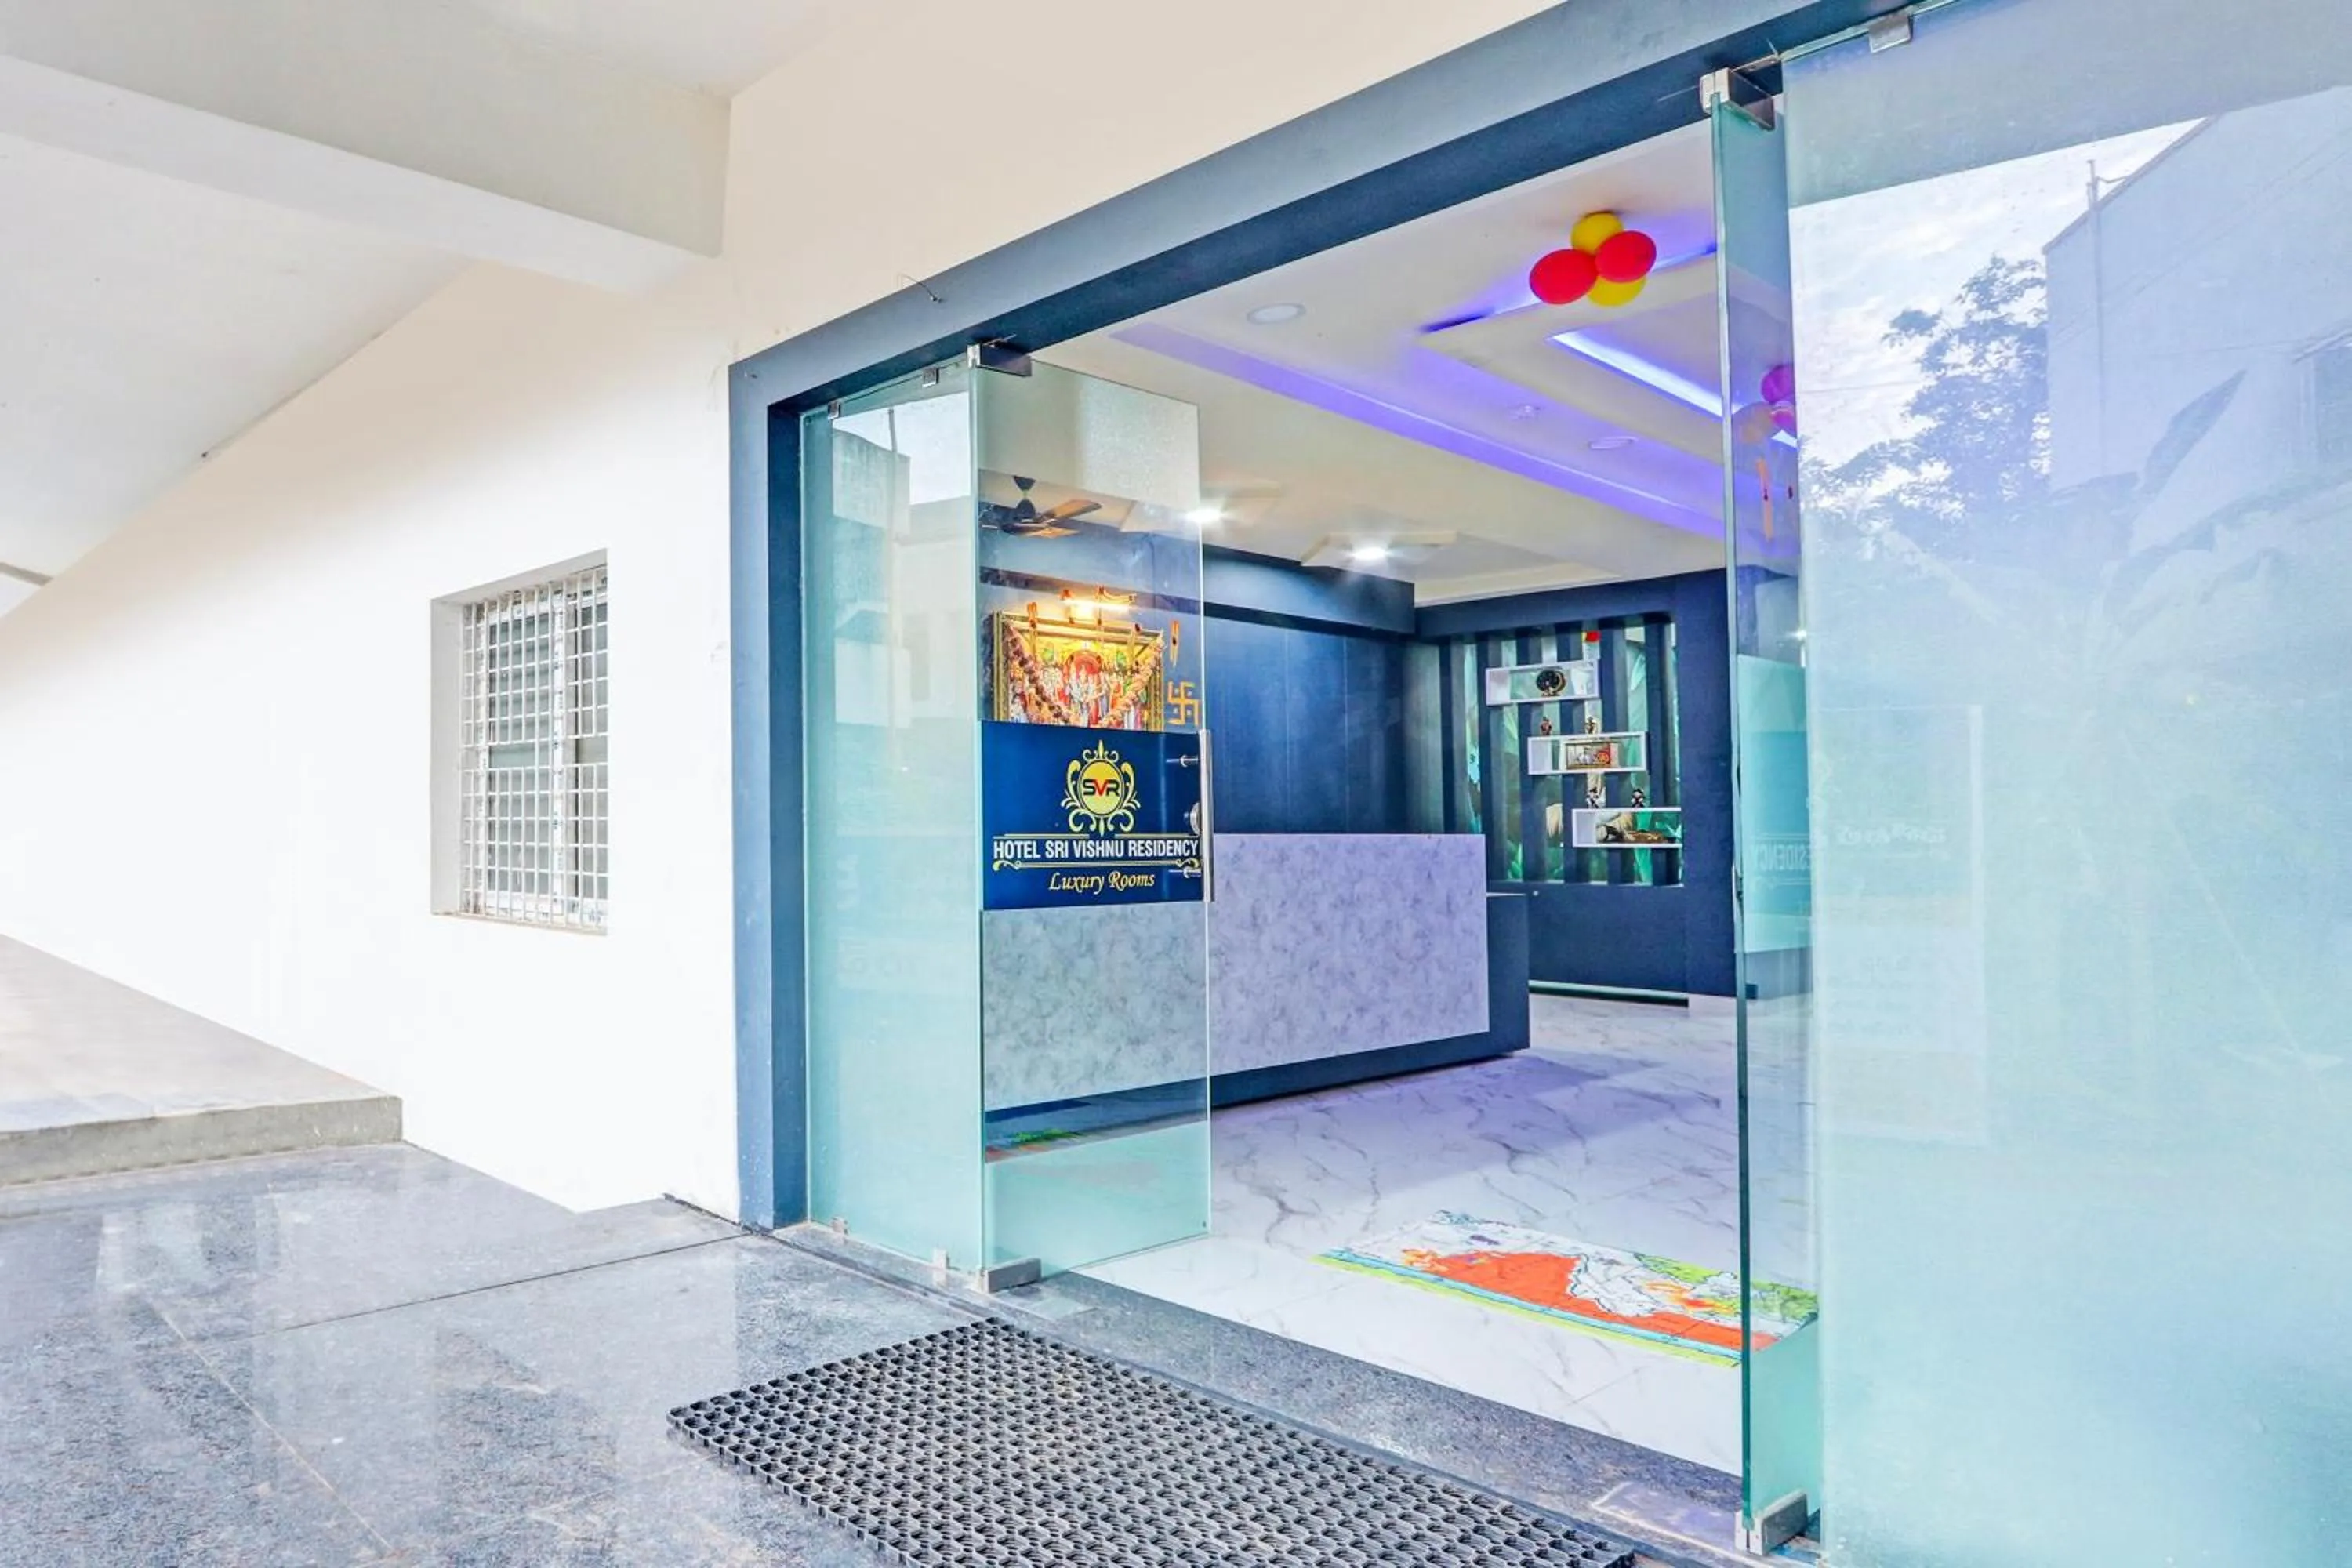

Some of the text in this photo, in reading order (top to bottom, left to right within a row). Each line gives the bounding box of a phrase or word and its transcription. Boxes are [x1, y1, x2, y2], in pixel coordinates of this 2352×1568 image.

[1083, 779, 1120, 797] SVR
[993, 840, 1199, 859] HOTEL SRI VISHNU RESIDENCY
[1048, 870, 1155, 894] Luxury Rooms
